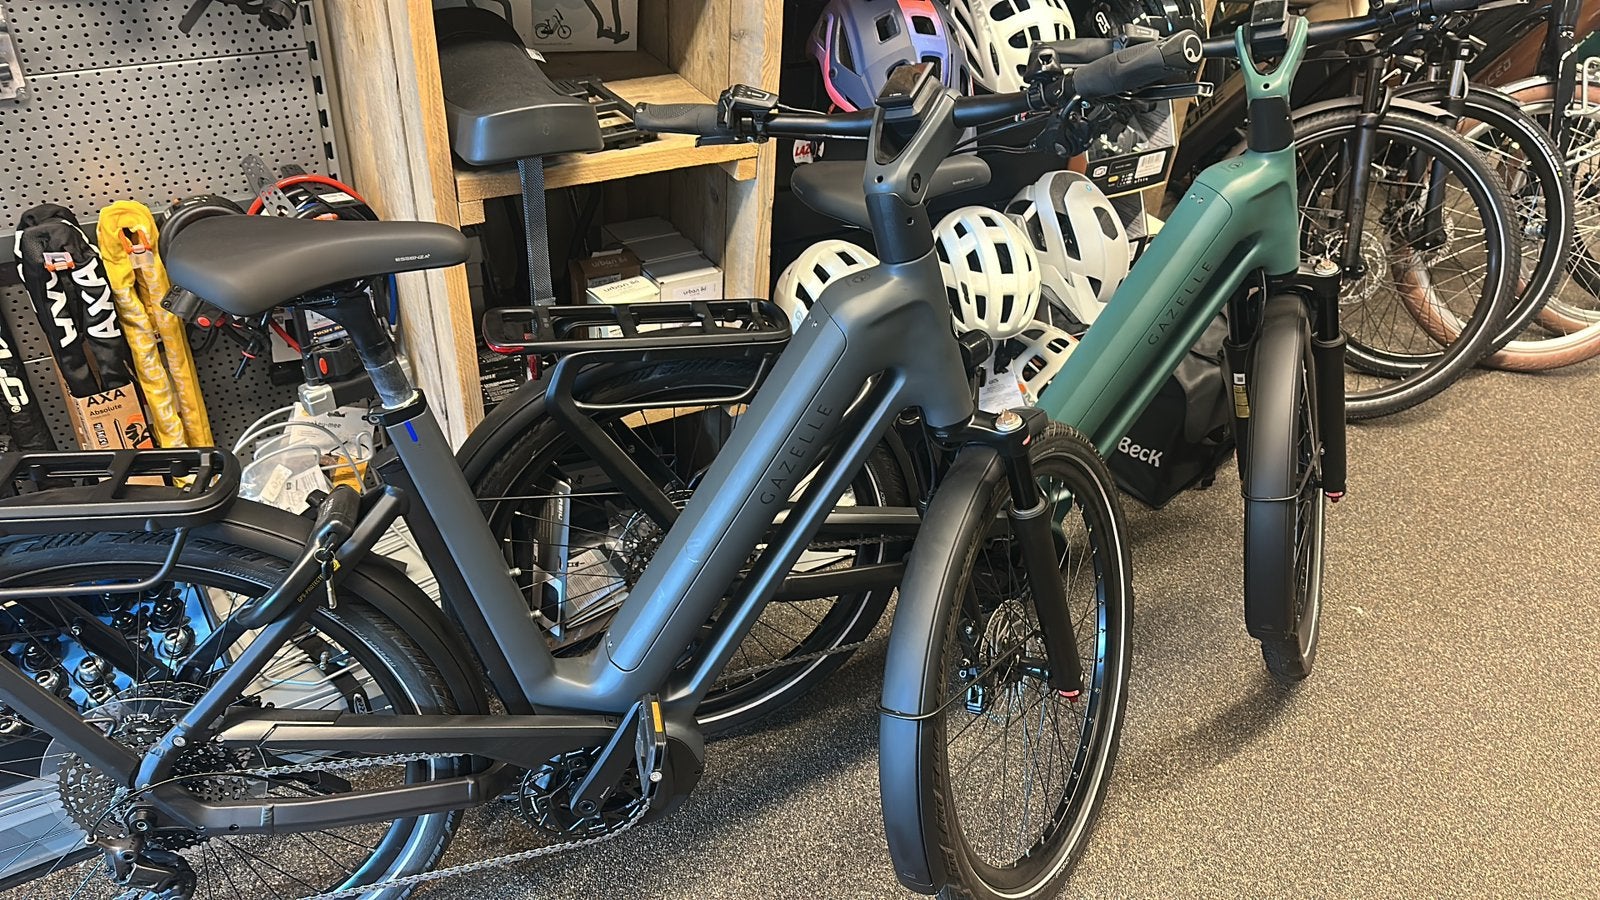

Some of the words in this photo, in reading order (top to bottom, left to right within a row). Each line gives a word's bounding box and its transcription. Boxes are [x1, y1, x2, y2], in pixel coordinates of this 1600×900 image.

[795, 143, 813, 157] LAZ
[72, 257, 122, 339] AXA
[682, 287, 700, 297] urban
[1147, 261, 1213, 346] GAZELLE
[86, 388, 127, 408] AXA
[89, 404, 123, 417] Absolute
[760, 404, 833, 505] GAZELLE
